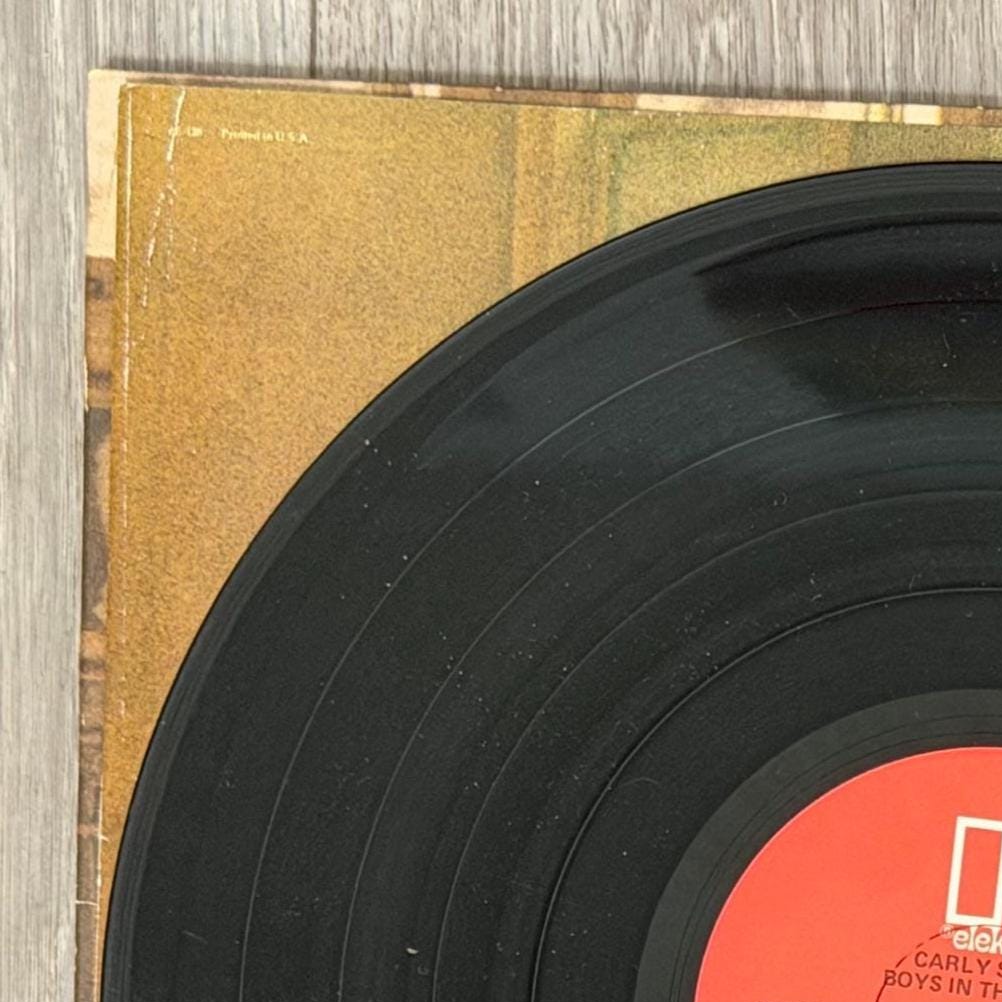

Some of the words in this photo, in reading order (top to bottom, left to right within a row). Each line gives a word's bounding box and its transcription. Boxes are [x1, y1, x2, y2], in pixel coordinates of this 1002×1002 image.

[914, 950, 991, 975] CARLY
[884, 970, 942, 993] BOYS
[948, 978, 972, 997] IN
